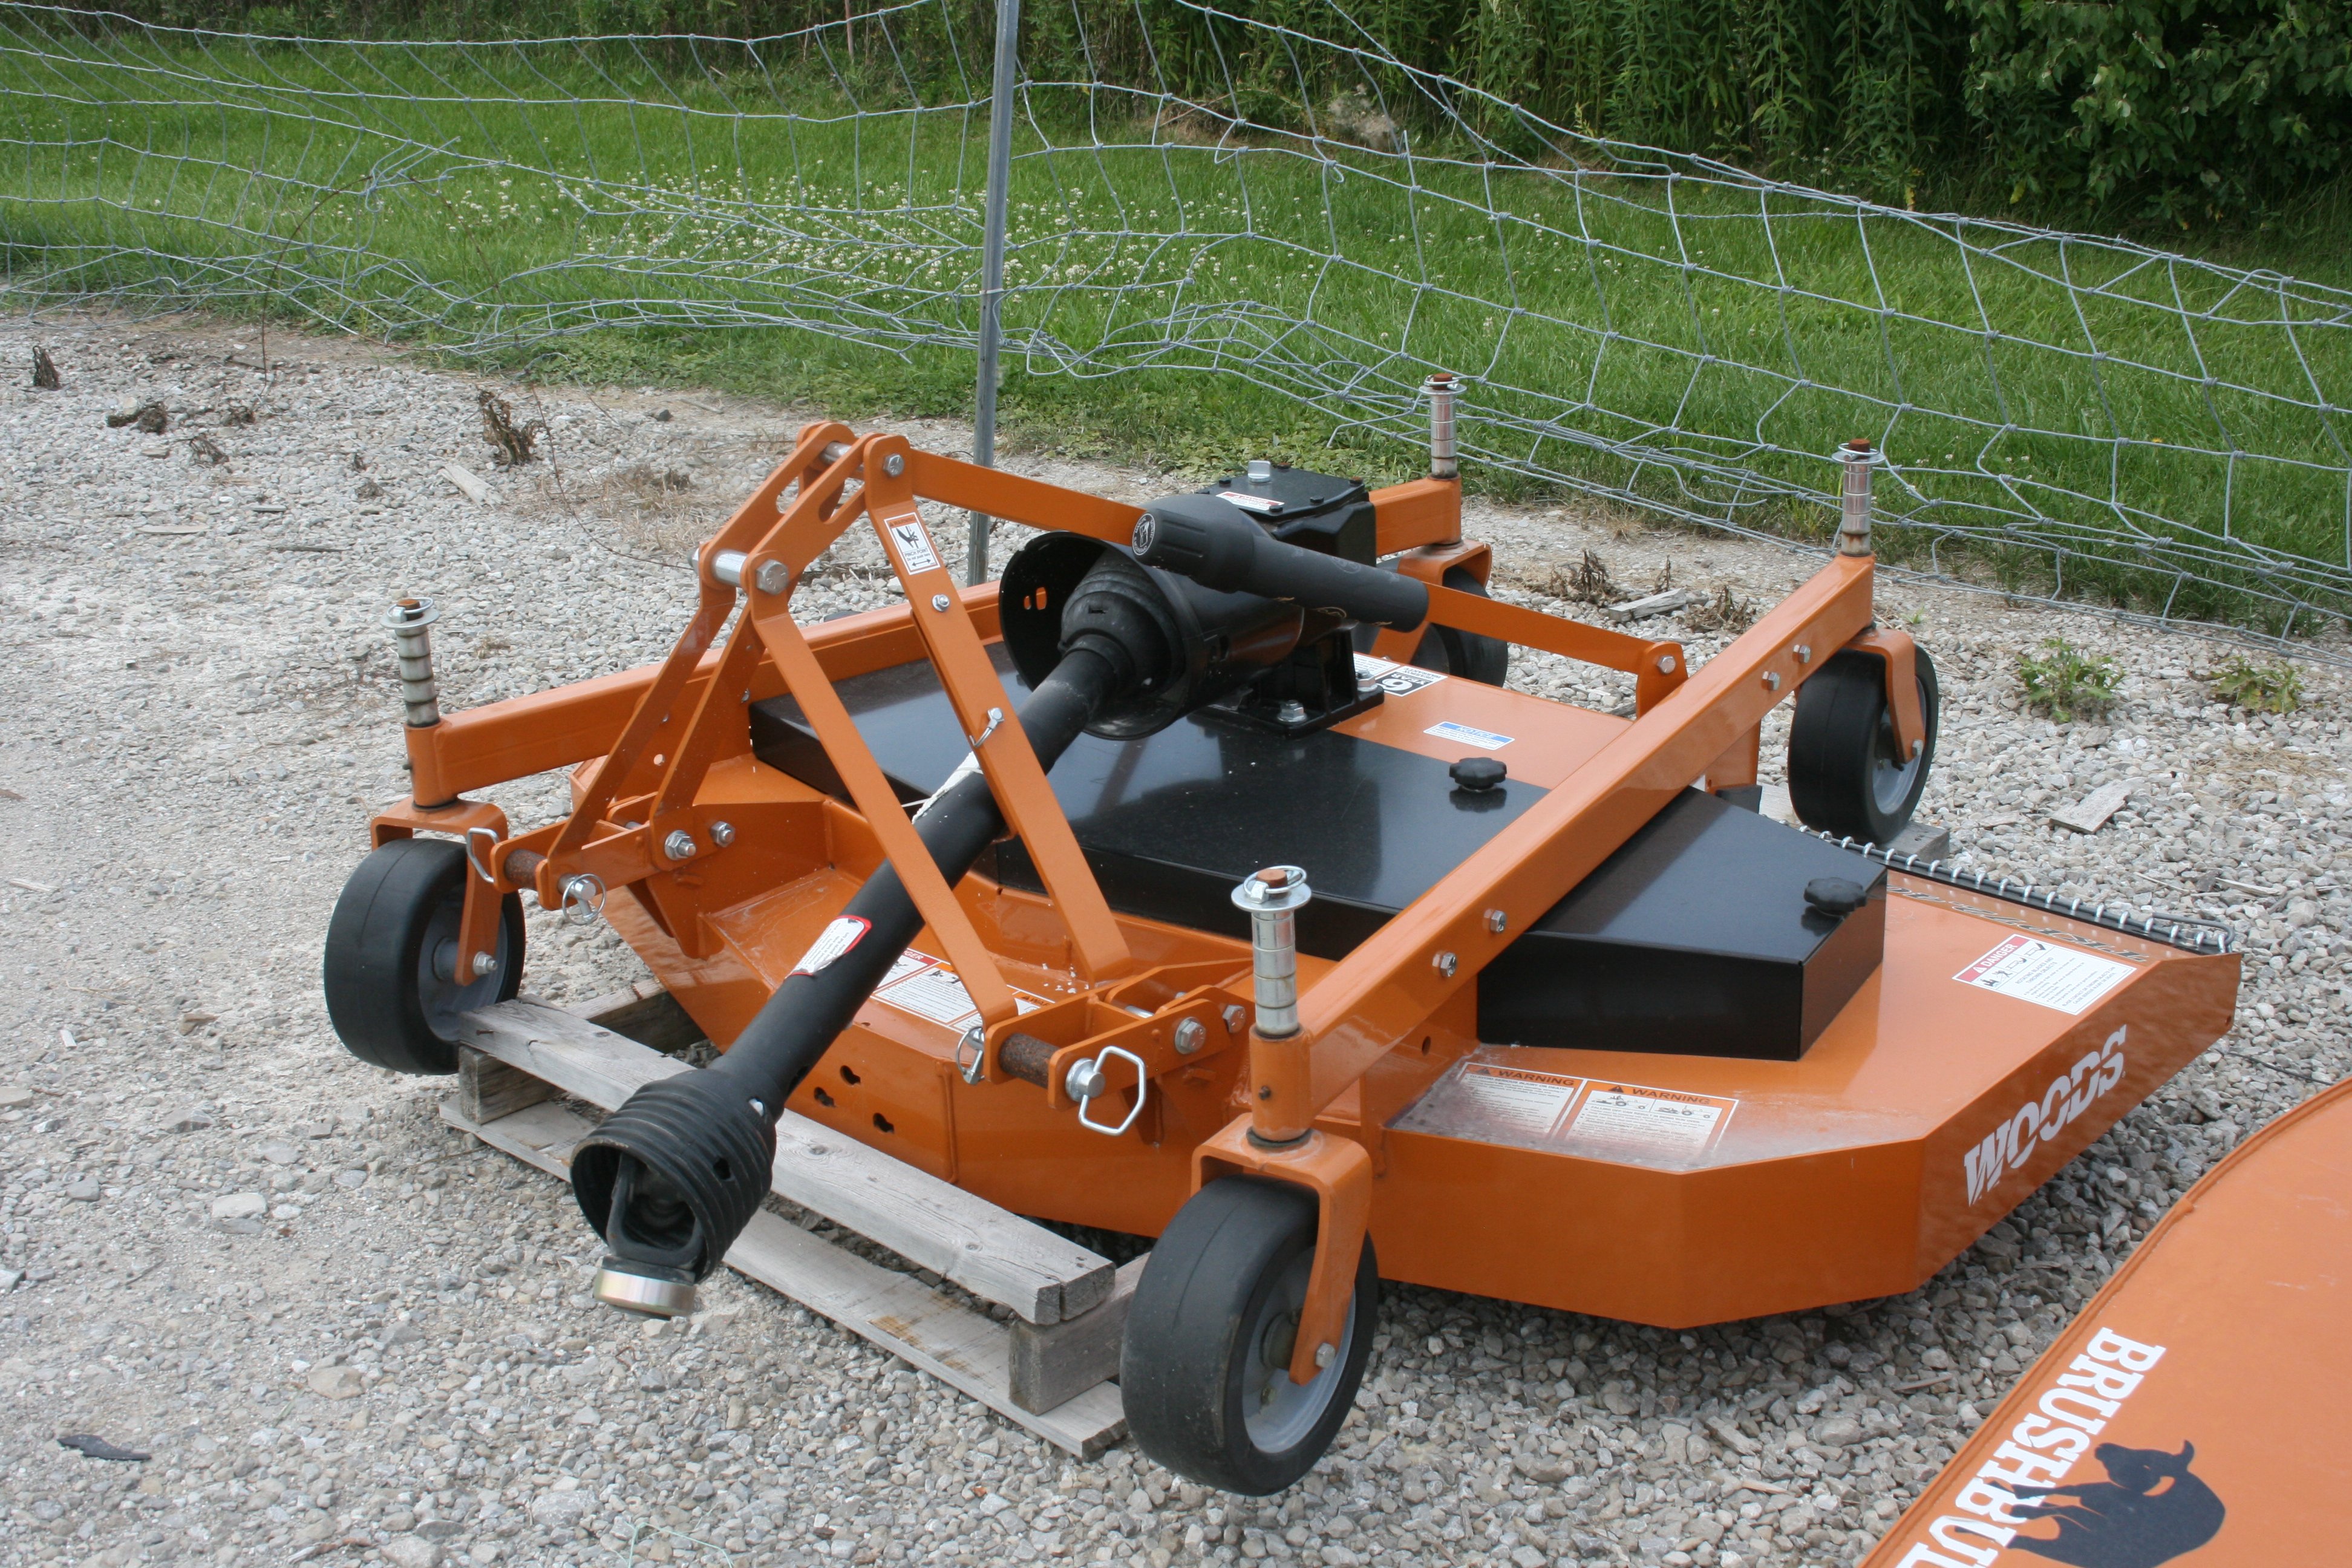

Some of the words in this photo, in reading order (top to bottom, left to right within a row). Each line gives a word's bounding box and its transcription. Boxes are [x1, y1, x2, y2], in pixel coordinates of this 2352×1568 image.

[1376, 678, 1413, 691] 6
[1391, 673, 1426, 685] YEAR
[1456, 726, 1495, 739] NOTICE
[1980, 943, 2018, 968] DANGER
[1499, 1070, 1574, 1086] WARNING
[1632, 1088, 1711, 1105] WARNING
[1964, 1024, 2126, 1207] WOODS
